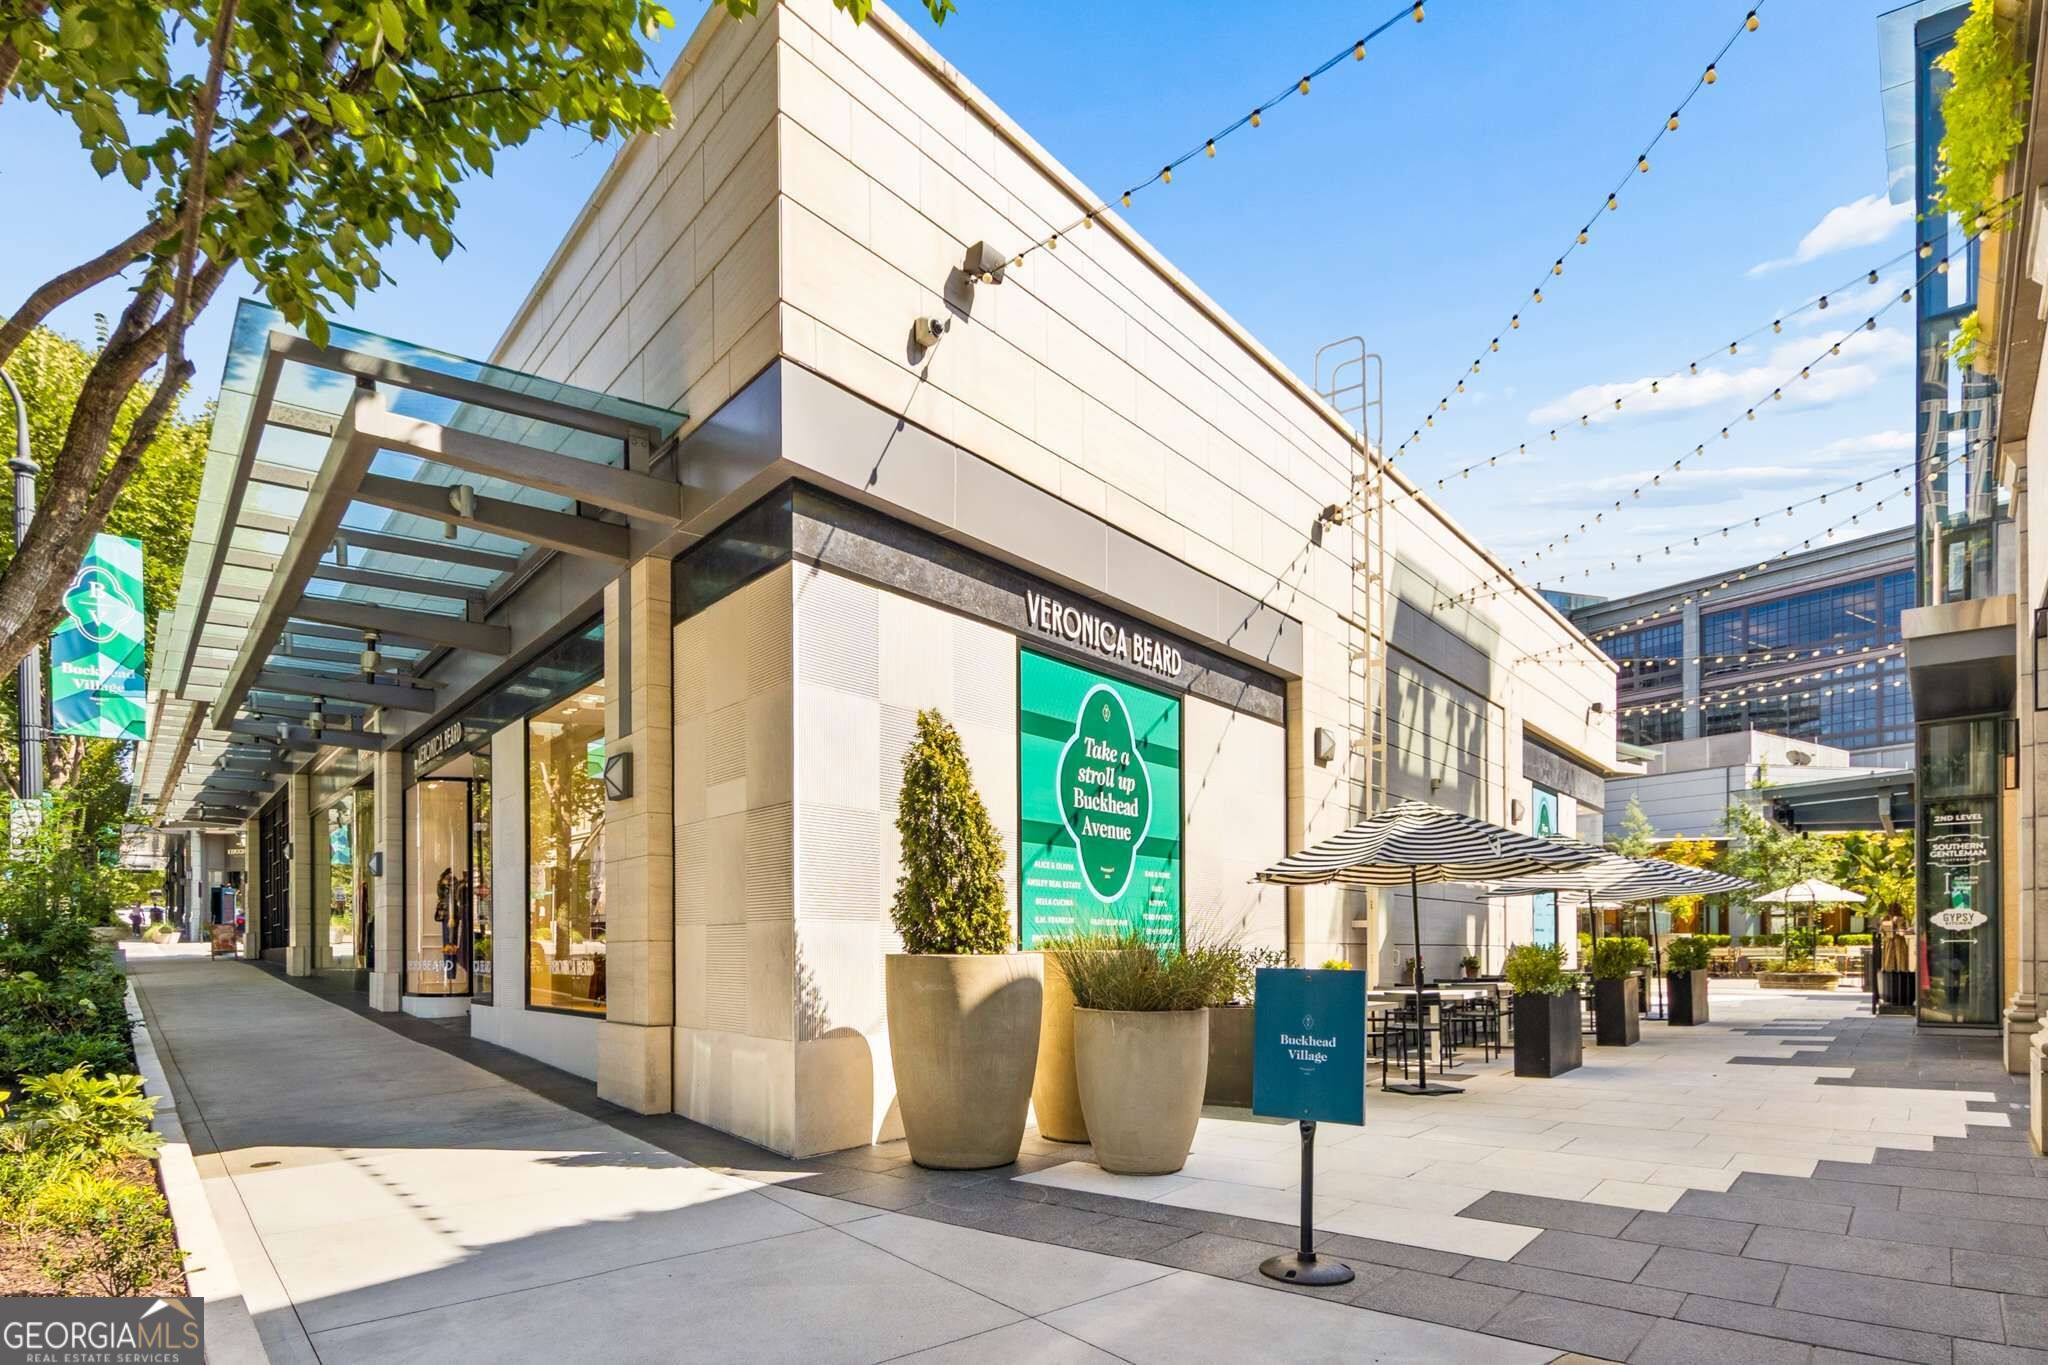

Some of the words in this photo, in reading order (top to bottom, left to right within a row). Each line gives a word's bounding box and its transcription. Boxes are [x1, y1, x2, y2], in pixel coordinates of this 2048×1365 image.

[88, 581, 105, 598] B
[88, 609, 106, 627] V
[1026, 589, 1128, 657] VERONICA
[1132, 632, 1182, 676] BEARD
[1084, 736, 1117, 763] Take
[1120, 751, 1130, 765] a
[1078, 766, 1114, 788] stroll
[1118, 775, 1136, 795] up
[1073, 787, 1139, 817] Buckhead
[1934, 814, 1954, 822] 2ND
[1955, 813, 1983, 821] LEVEL
[1082, 815, 1132, 841] Avenue
[1929, 849, 1987, 858] GENTLEMAN
[1932, 842, 1984, 851] SOUTHERN
[1943, 912, 1975, 922] GYPSY
[1280, 1034, 1336, 1048] Buckhead
[1288, 1049, 1328, 1063] Village
